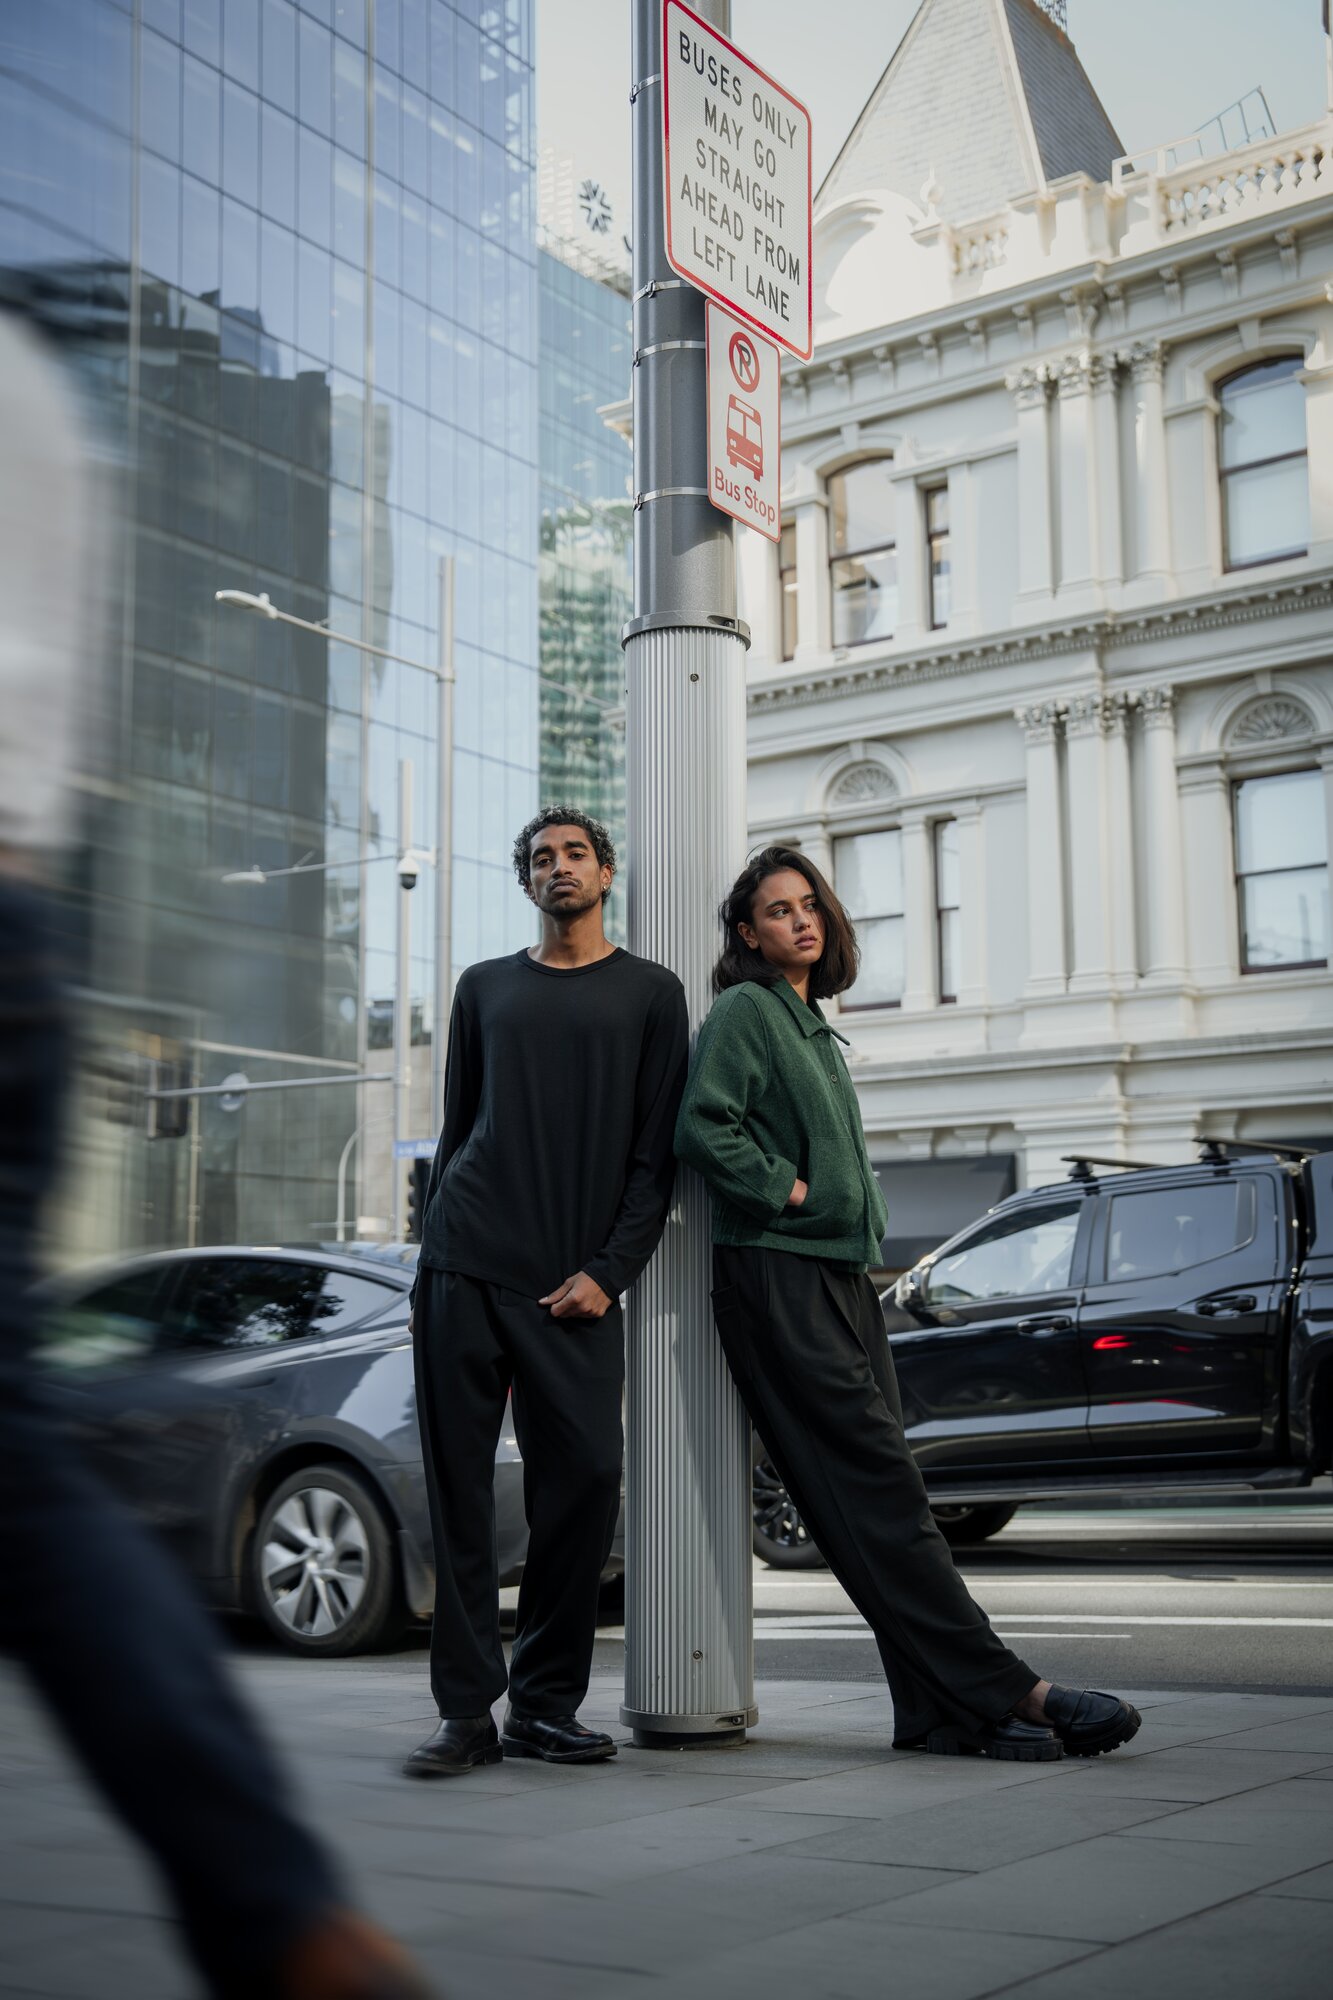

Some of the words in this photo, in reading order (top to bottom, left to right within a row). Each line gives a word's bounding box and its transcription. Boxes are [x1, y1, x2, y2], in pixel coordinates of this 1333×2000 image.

[679, 30, 742, 107] BUSES
[752, 93, 797, 149] ONLY
[696, 138, 785, 228] STRAIGHT
[704, 97, 743, 151] MAY
[754, 139, 776, 177] GO
[681, 174, 744, 242] AHEAD
[754, 227, 800, 286] FROM
[692, 227, 736, 281] LEFT
[746, 265, 789, 322] LANE
[714, 467, 740, 502] Bus
[744, 486, 776, 526] Stop
